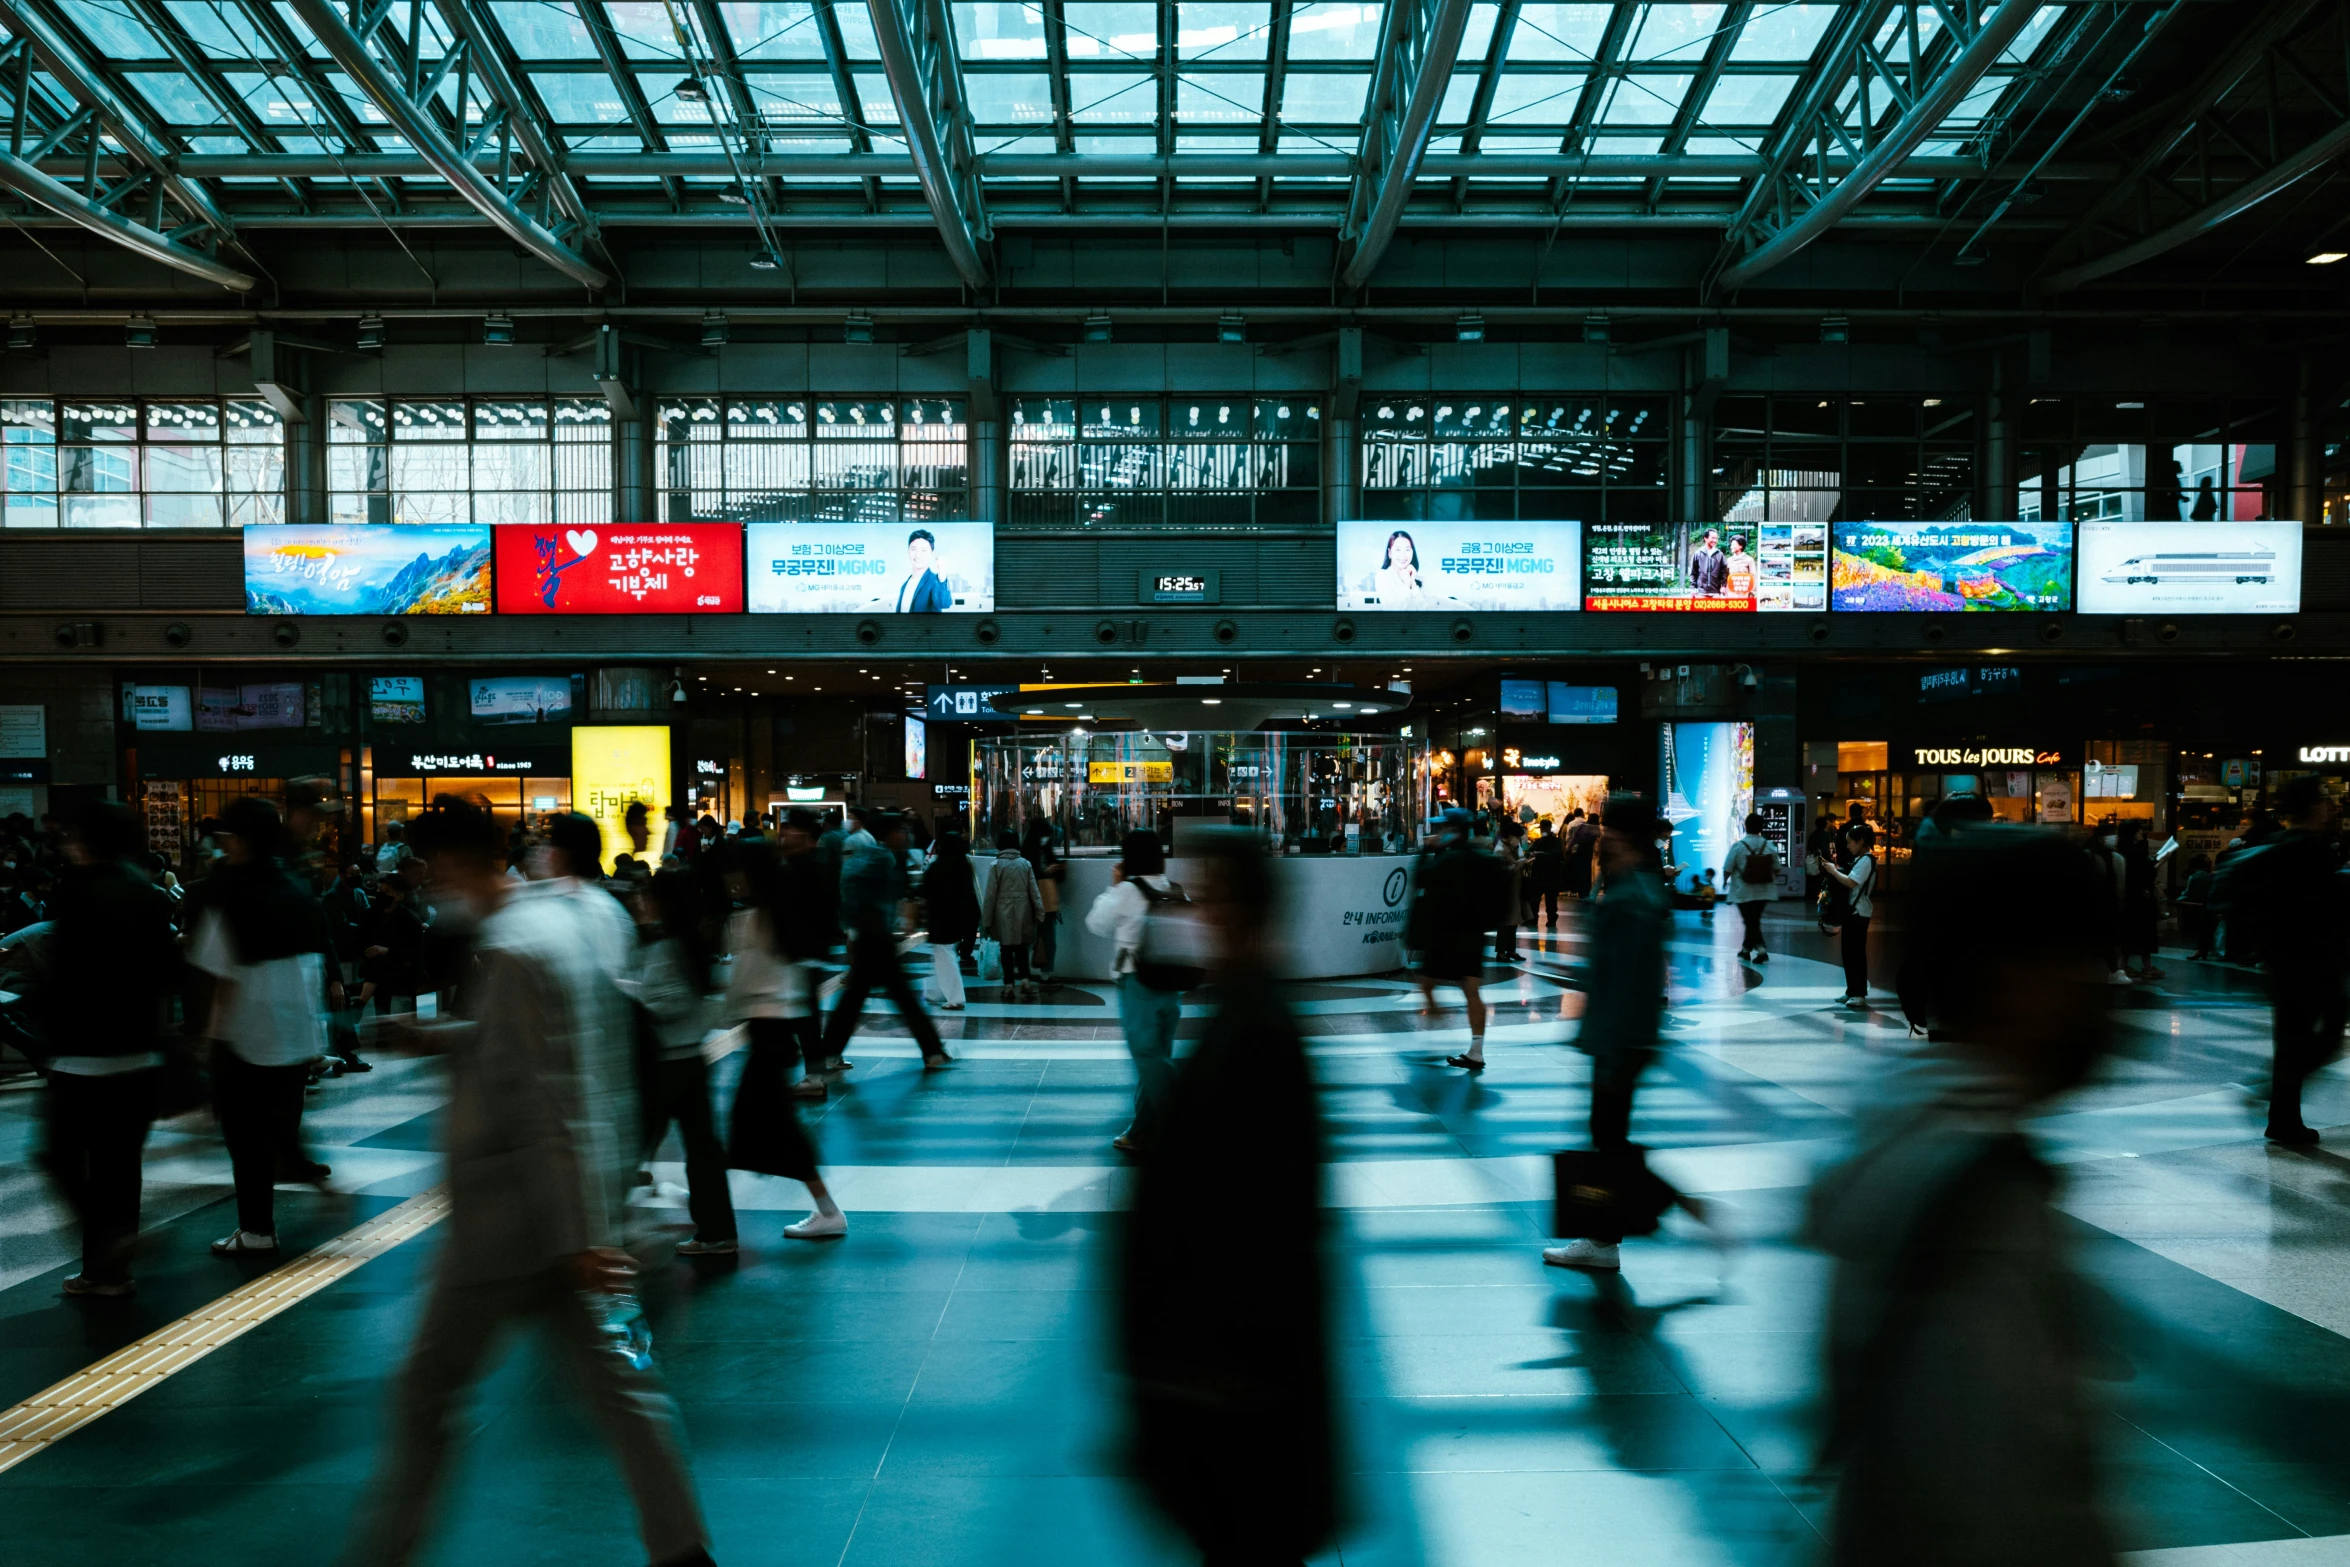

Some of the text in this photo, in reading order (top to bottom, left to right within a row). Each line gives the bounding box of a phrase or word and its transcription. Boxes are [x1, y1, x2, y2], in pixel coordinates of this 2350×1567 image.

[1862, 536, 1889, 546] 2023
[1892, 535, 1948, 546] 세계유산도시
[1951, 535, 1998, 546] 고창방문의
[2001, 535, 2011, 546] 해
[792, 544, 864, 555] 보험 그 이상으로
[1462, 542, 1534, 554] 금융 그 이상으로
[610, 548, 699, 577] 고향사랑
[772, 559, 886, 576] 무궁무진! MGMG
[1441, 558, 1554, 574] 무궁무진! MGMG
[304, 552, 362, 591] 영암
[1592, 568, 1674, 582] 고창 웰파크시티
[608, 573, 668, 600] 기부제
[1160, 577, 1194, 591] 15:25
[1592, 598, 1748, 610] 서울시니어스 고창타워 분양 02)2668-5300
[411, 754, 484, 770] 부산미도어묵
[1522, 756, 1560, 769] Instyle
[1915, 749, 1961, 765] TOUS
[1963, 748, 1980, 764] les
[1981, 749, 2034, 767] JOURS
[1128, 768, 1134, 776] 2
[1343, 911, 1364, 925] 안내
